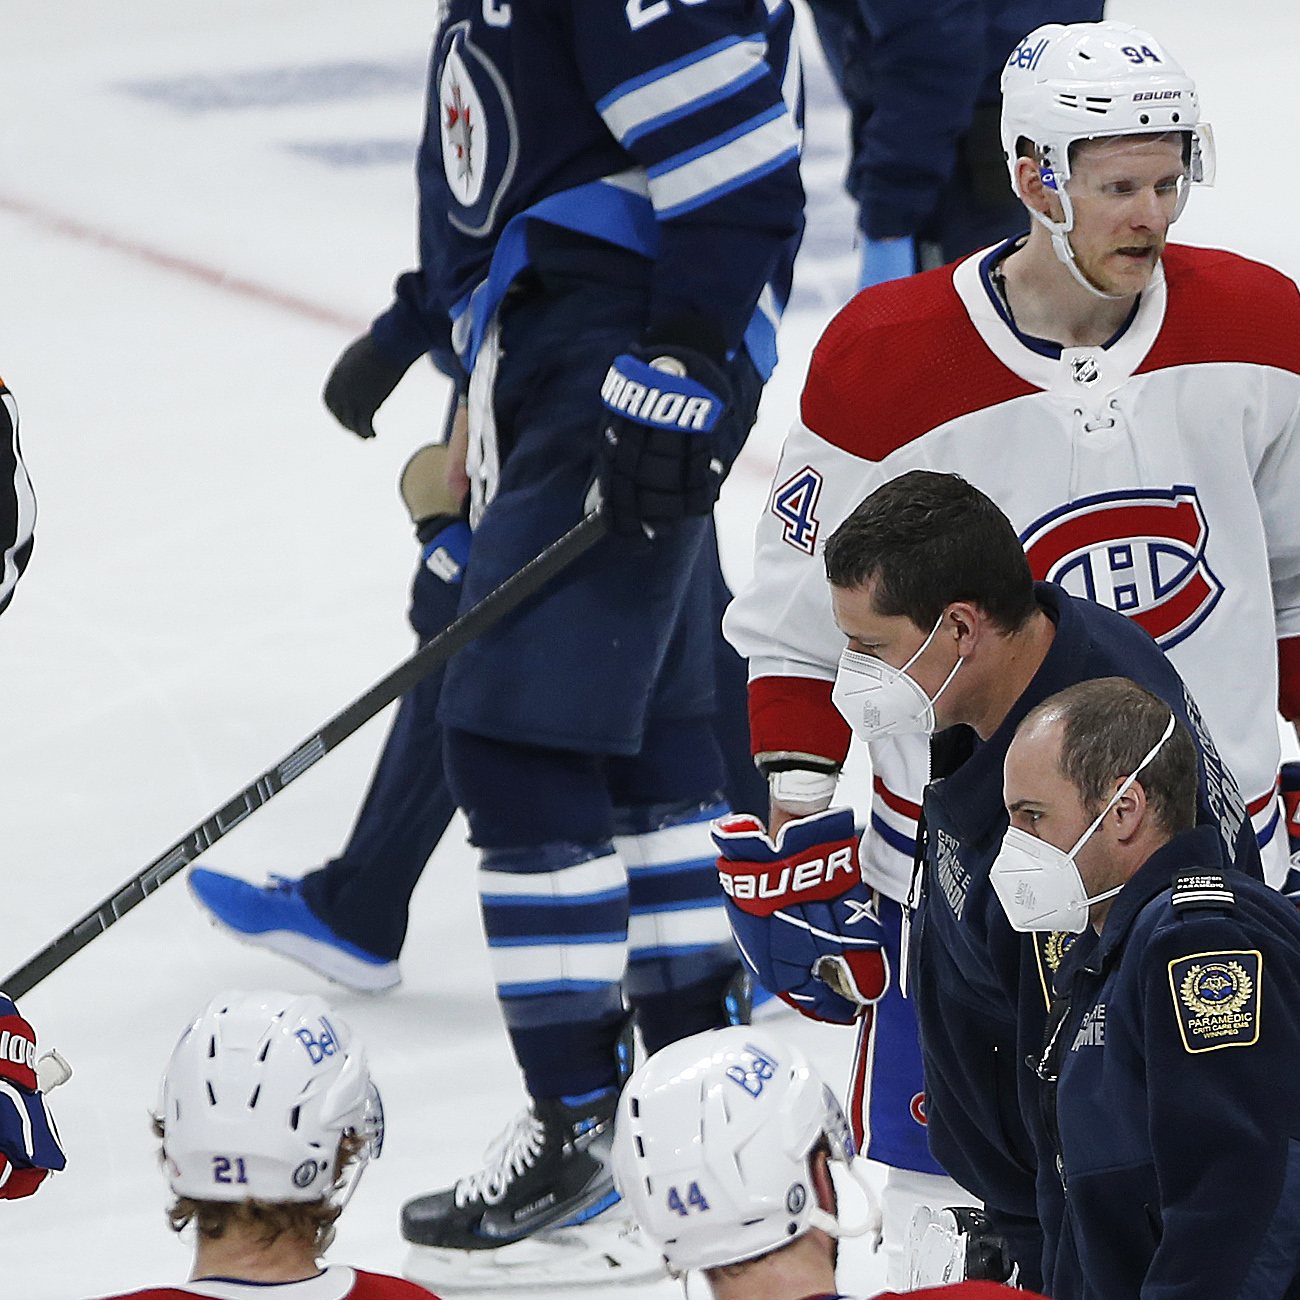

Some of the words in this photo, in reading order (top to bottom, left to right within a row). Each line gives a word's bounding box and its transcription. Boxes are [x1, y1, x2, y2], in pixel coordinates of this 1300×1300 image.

[1121, 45, 1162, 65] 94
[1132, 91, 1182, 102] BAUER
[773, 464, 821, 555] 4
[1188, 1012, 1253, 1029] PARAMEDIC
[1203, 1029, 1239, 1039] WINNIPEG
[294, 1015, 341, 1065] Bell
[726, 1043, 778, 1098] Bell
[212, 1157, 248, 1184] 21
[667, 1181, 710, 1217] 44
